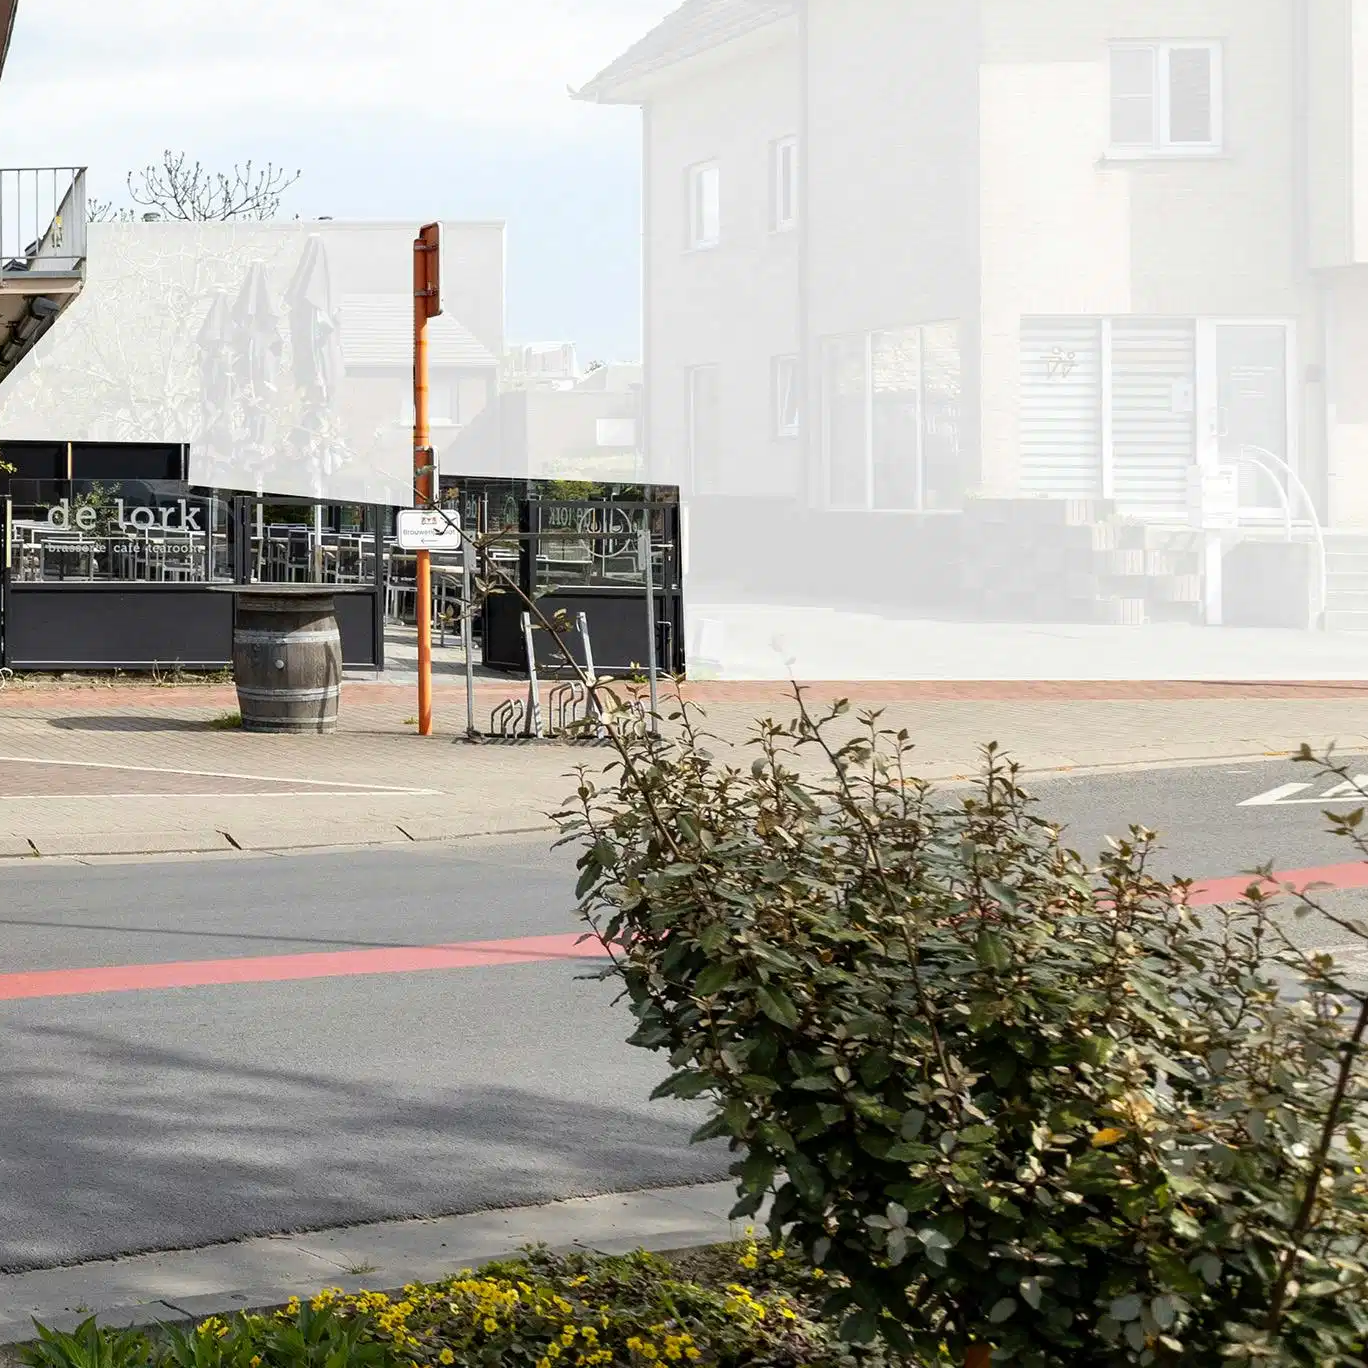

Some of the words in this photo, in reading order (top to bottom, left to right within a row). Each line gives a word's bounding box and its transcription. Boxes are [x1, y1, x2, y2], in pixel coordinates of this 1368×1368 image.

[48, 498, 97, 530] de
[114, 499, 201, 530] lork
[48, 542, 106, 553] brasserie
[113, 543, 140, 553] café
[147, 543, 206, 553] tearoom
